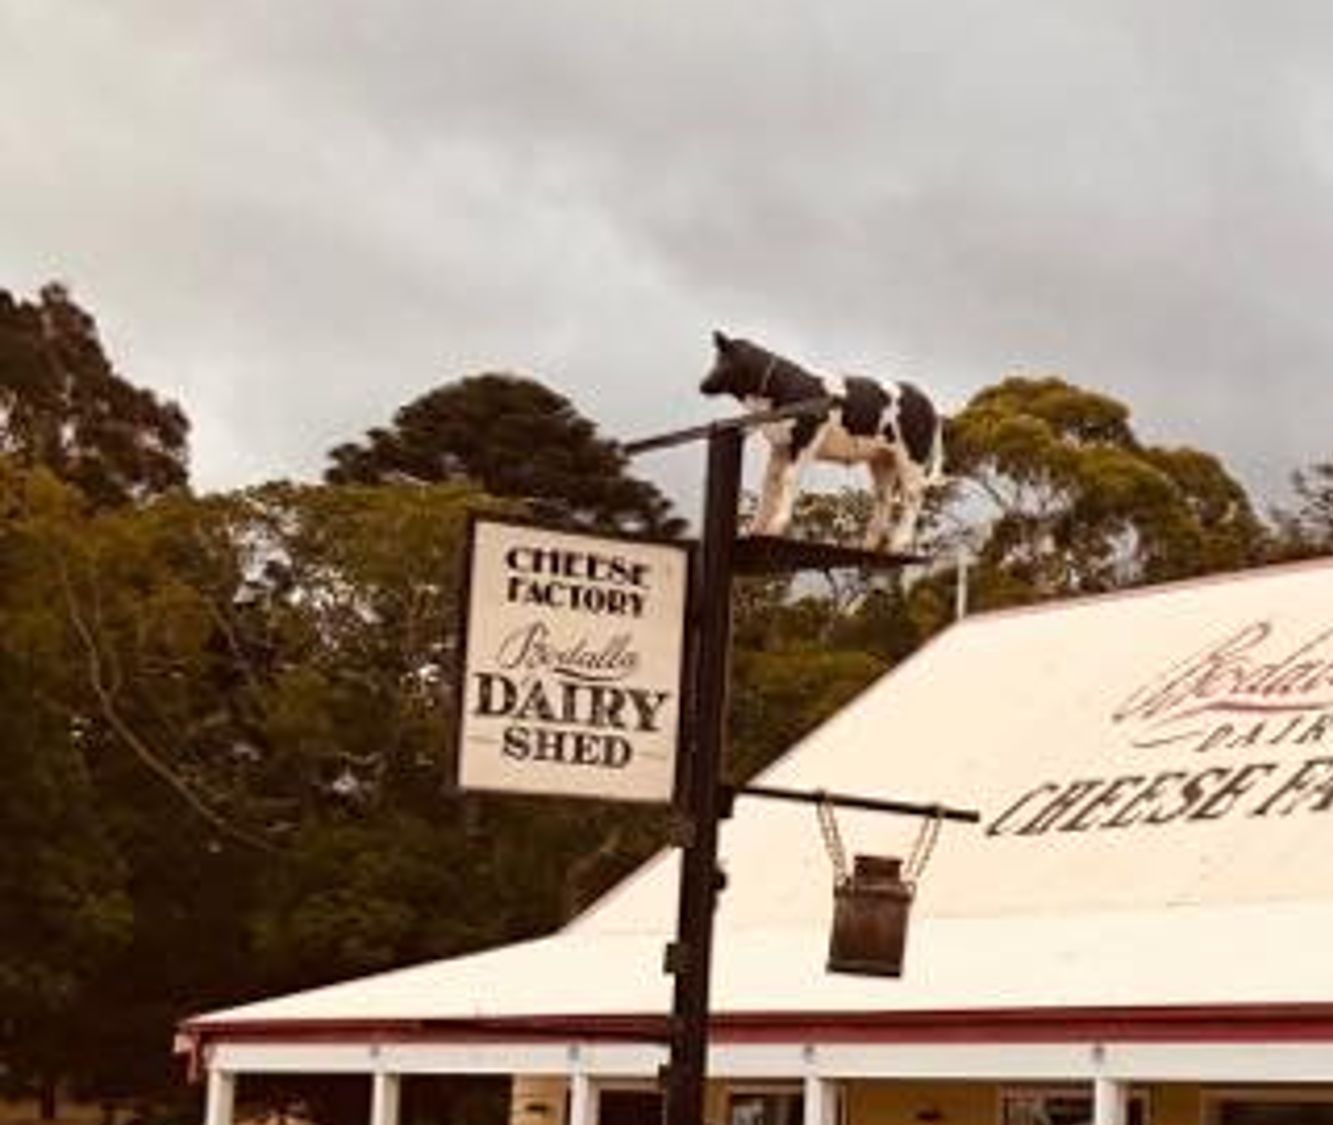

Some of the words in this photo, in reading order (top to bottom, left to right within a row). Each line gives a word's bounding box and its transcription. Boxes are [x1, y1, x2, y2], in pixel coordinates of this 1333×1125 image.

[505, 546, 650, 588] CHEESE
[507, 576, 647, 619] FACTORY
[473, 671, 672, 732] DAIRY
[502, 725, 633, 769] SHED
[984, 762, 1279, 838] CHEESE
